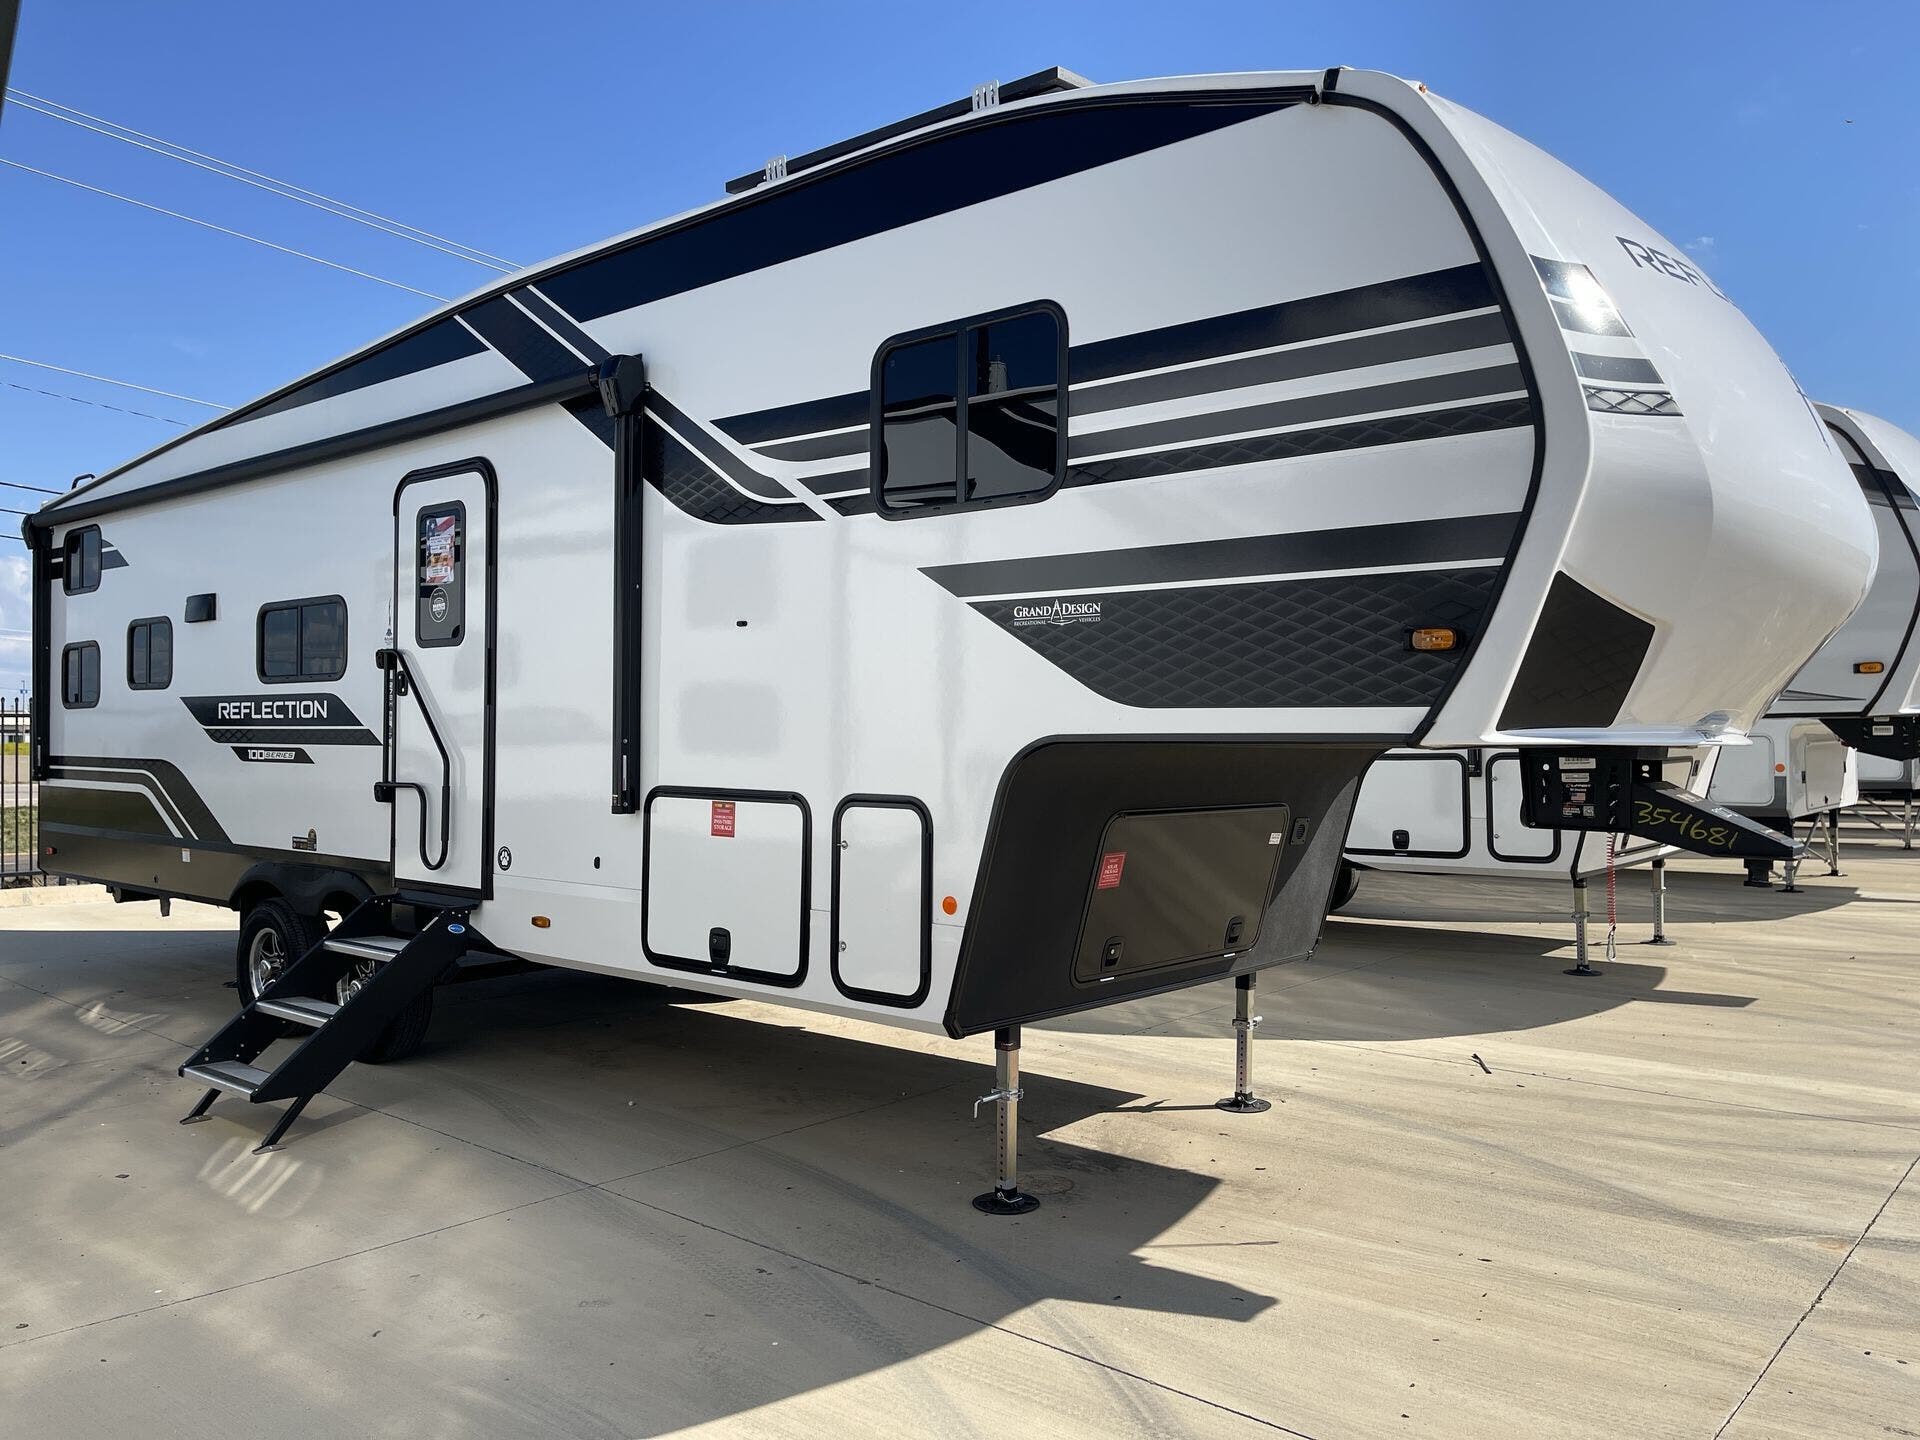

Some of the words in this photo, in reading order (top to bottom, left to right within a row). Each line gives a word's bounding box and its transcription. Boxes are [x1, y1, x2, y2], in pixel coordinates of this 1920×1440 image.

[1013, 606, 1052, 618] GRAND
[1062, 602, 1101, 615] DESIGN
[218, 700, 328, 719] REFLECTION
[247, 749, 265, 760] 100
[265, 751, 295, 760] SERIES
[1634, 800, 1739, 849] 354681
